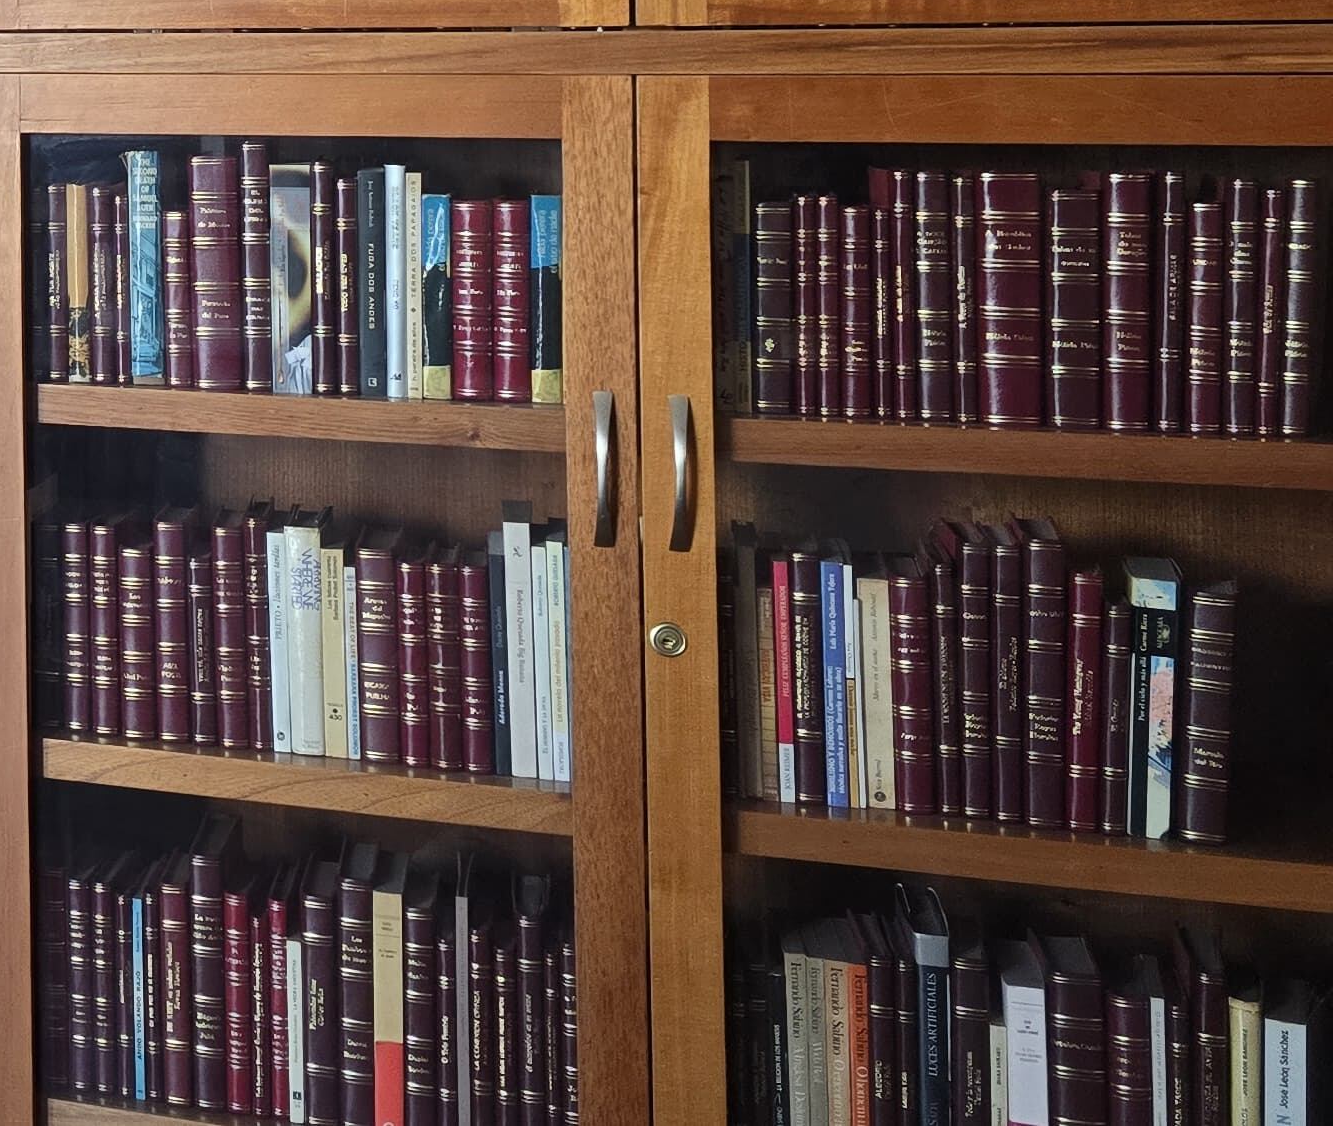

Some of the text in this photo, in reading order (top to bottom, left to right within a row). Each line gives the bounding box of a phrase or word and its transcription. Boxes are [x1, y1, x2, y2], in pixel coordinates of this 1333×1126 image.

[367, 243, 376, 330] FUGA DOS ANDES
[291, 566, 302, 610] STARTED
[301, 548, 314, 611] WHERE WE
[312, 559, 322, 611] ARRIVING
[515, 589, 525, 616] Roberto
[274, 610, 283, 641] PRIETO
[1139, 613, 1149, 652] Carme Riera
[516, 647, 525, 659] Big
[1137, 656, 1147, 668] allá
[1071, 722, 1082, 736] The
[1137, 711, 1146, 722] Por
[790, 961, 803, 1039] Fernando Sabino
[810, 966, 821, 1035] Fernando Sabino
[831, 967, 844, 1056] Fernando Sabino
[854, 973, 867, 1023] Fernando
[856, 1027, 867, 1063] Sabino
[925, 972, 940, 1077] LUCES ARTIFICIALES
[1277, 1029, 1291, 1109] José León Sánchez
